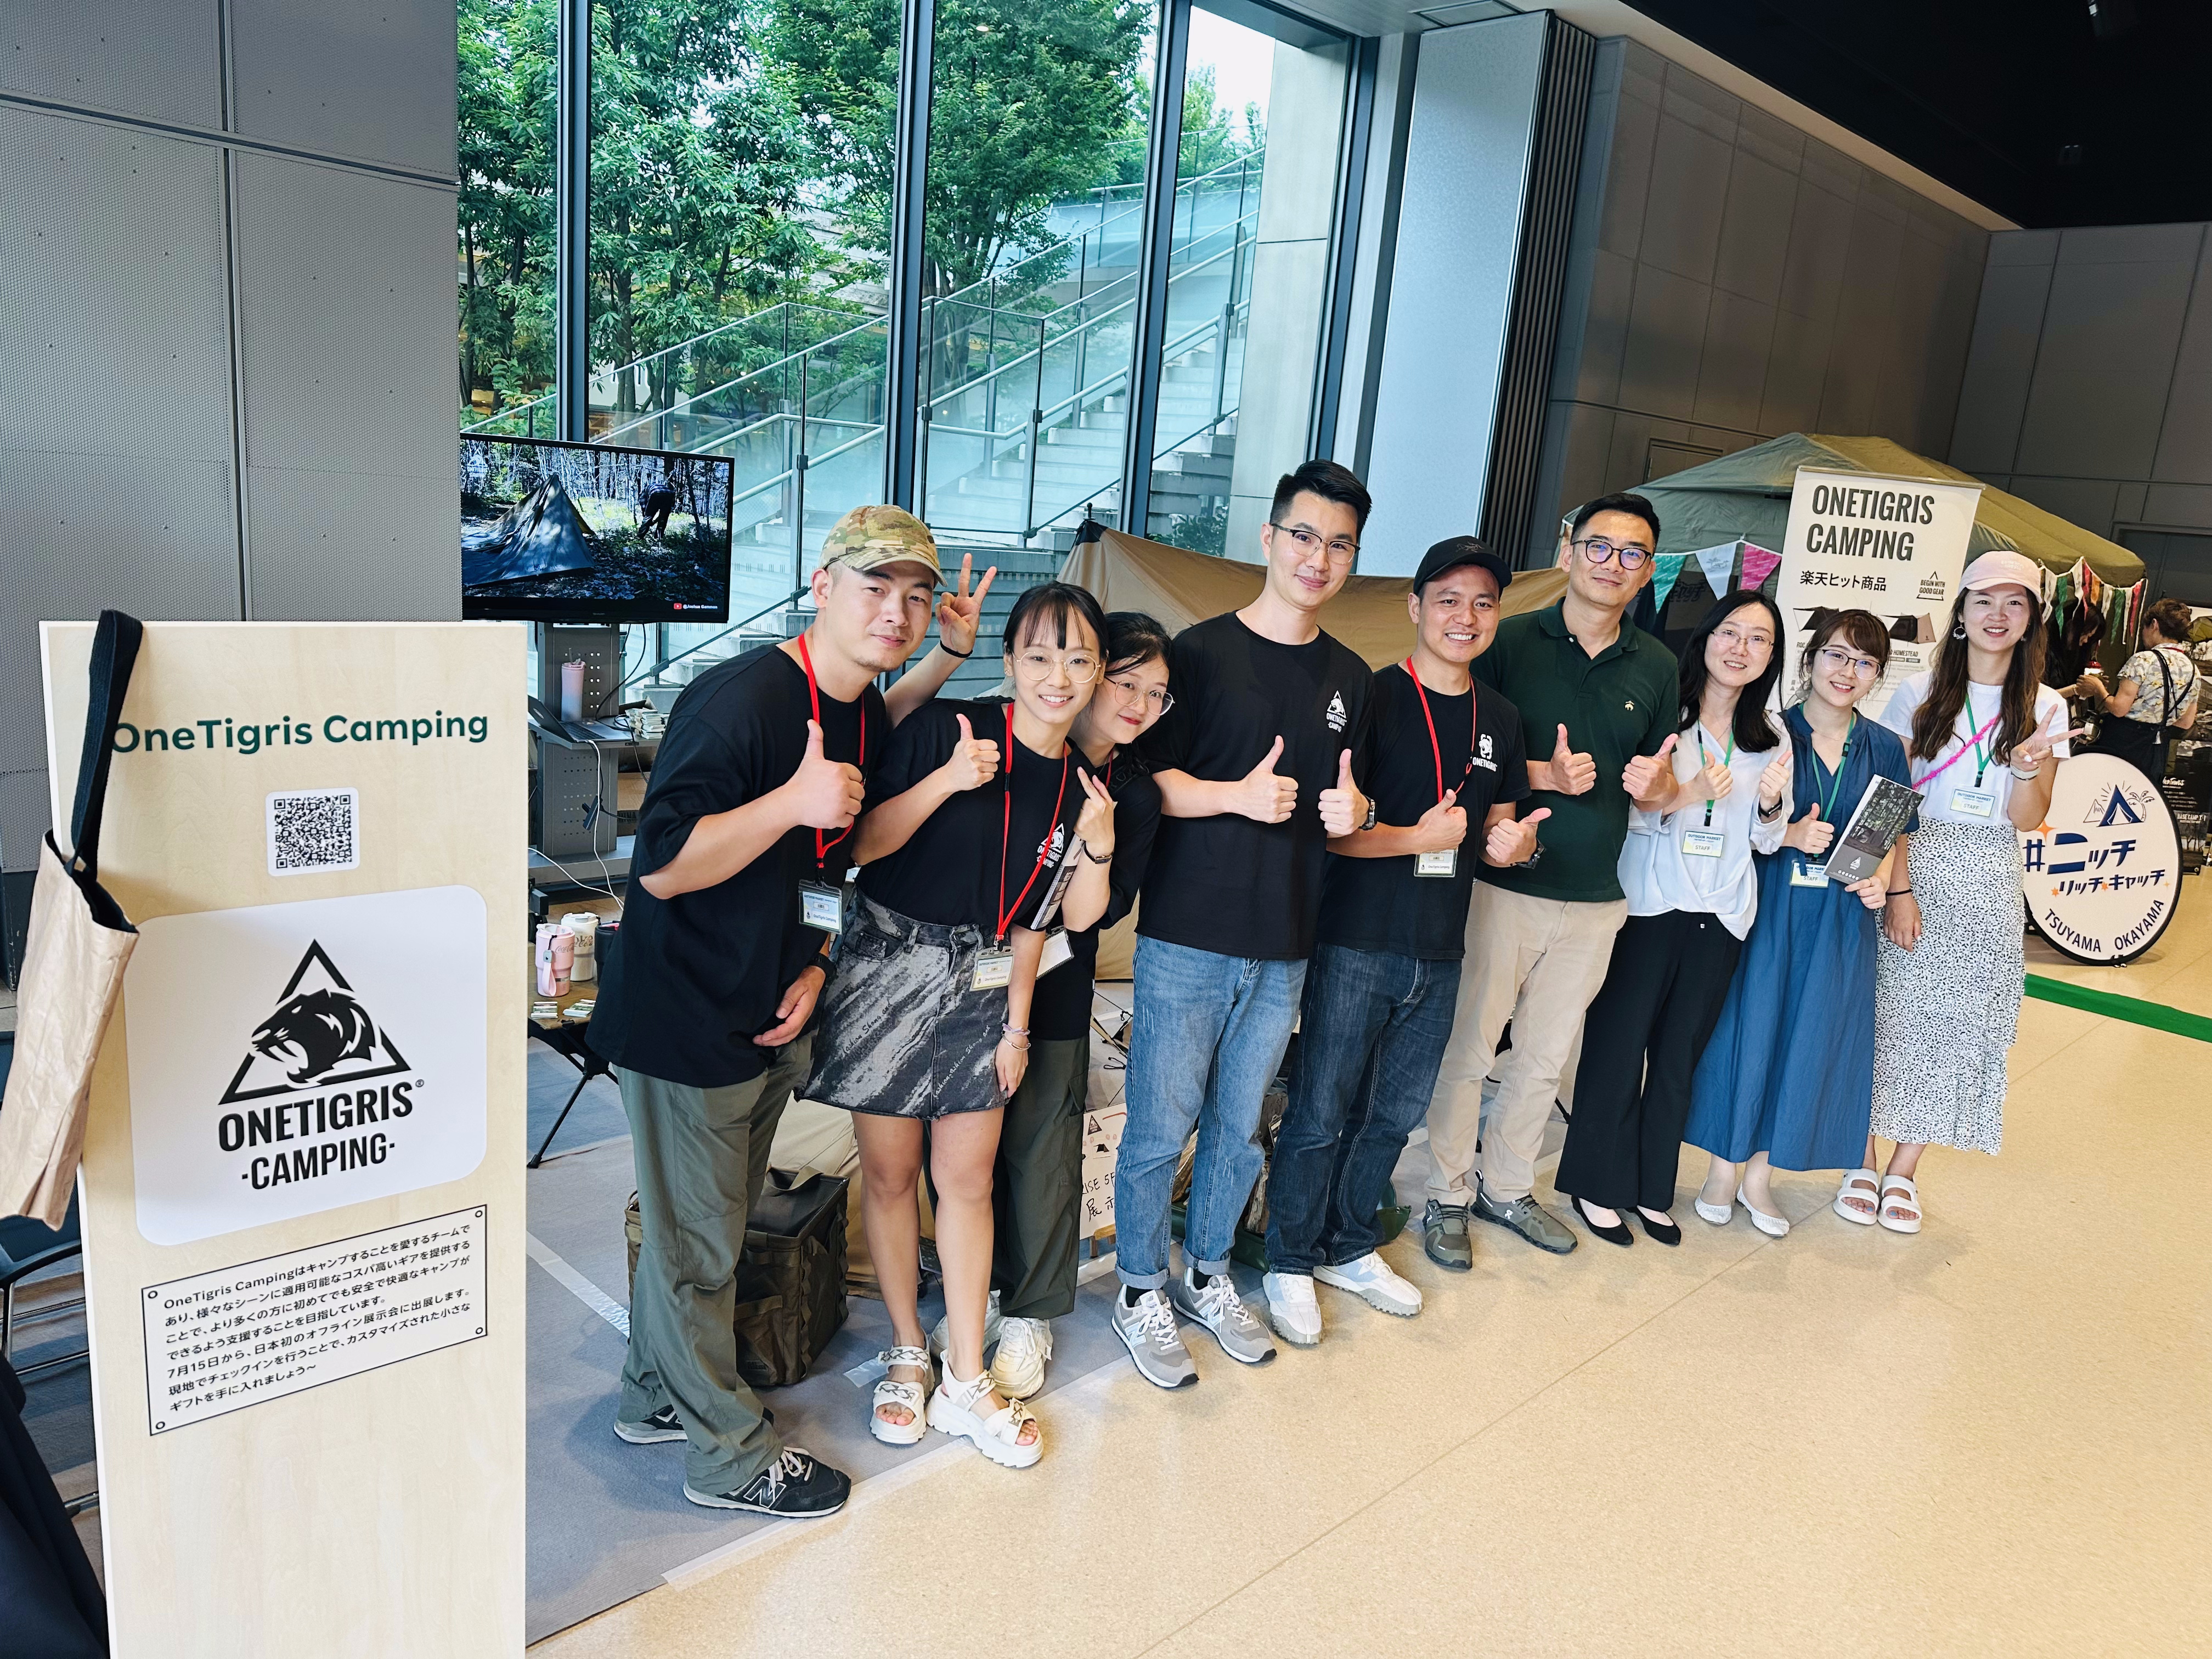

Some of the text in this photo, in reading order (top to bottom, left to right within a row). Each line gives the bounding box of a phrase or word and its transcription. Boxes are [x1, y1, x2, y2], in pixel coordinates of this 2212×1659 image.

[1812, 485, 1934, 524] ONETIGRIS
[1806, 523, 1914, 561] CAMPING
[1800, 570, 1887, 591] 楽天ヒット商品
[112, 710, 488, 754] OneTigris Camping
[2045, 900, 2164, 952] TSUYAMA OKAYAMA
[1082, 1178, 1101, 1194] ISE
[164, 1285, 232, 1309] OneTigris
